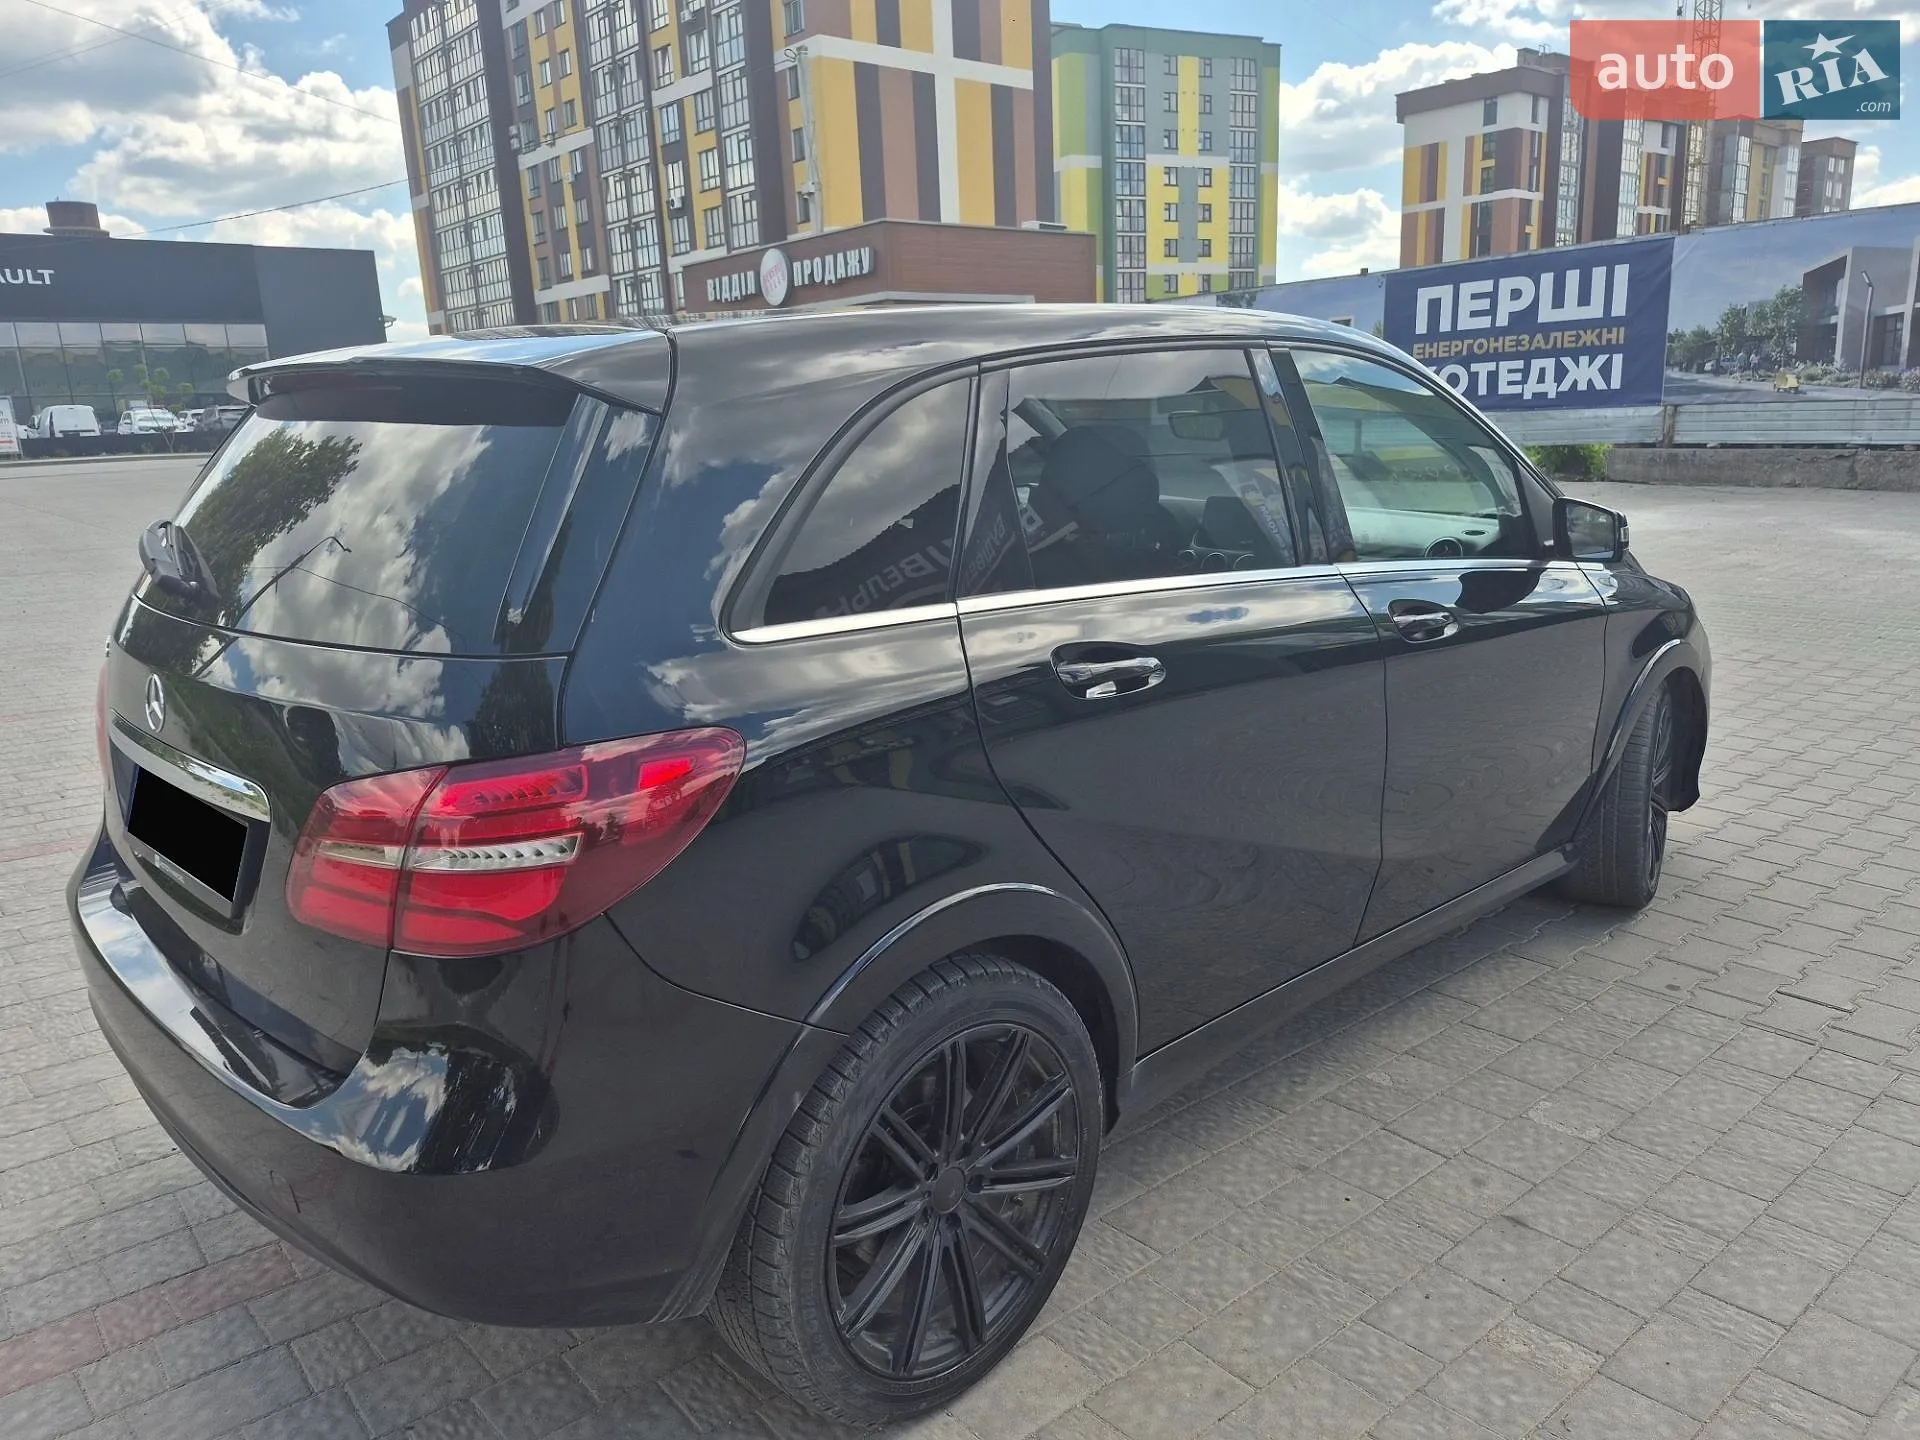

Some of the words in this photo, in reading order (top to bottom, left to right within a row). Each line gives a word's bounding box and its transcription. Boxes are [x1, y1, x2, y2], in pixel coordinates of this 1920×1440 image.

[706, 270, 757, 303] ВІДДІЛ
[792, 246, 871, 287] ПРОДАЖУ
[1415, 263, 1630, 335] ПЕРШІ
[1412, 326, 1626, 360] ЕНЕРГОНЕЗАЛЕЖНІ
[1428, 353, 1623, 400] ОТЕДЖІ
